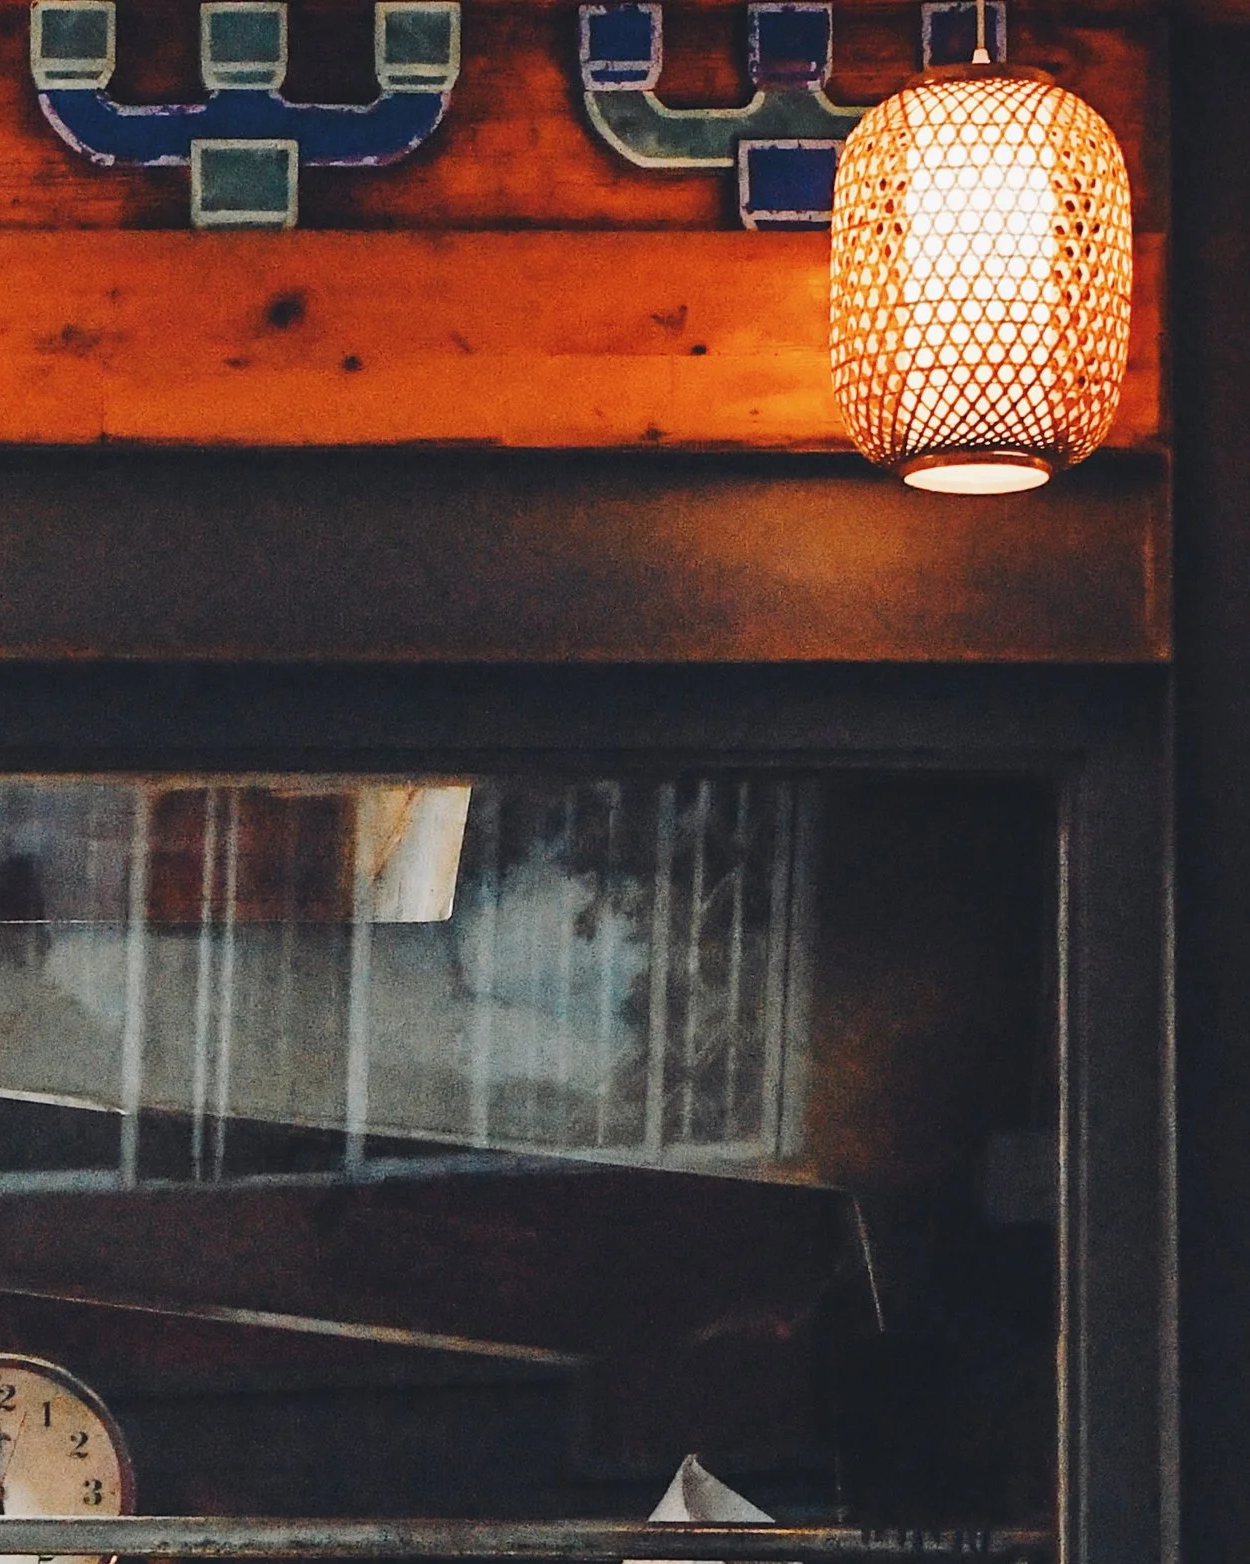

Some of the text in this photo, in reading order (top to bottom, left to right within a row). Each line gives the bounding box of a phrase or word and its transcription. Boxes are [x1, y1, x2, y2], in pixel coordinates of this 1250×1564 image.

[42, 1401, 51, 1428] 1
[70, 1431, 89, 1459] 2
[83, 1478, 103, 1506] 3
